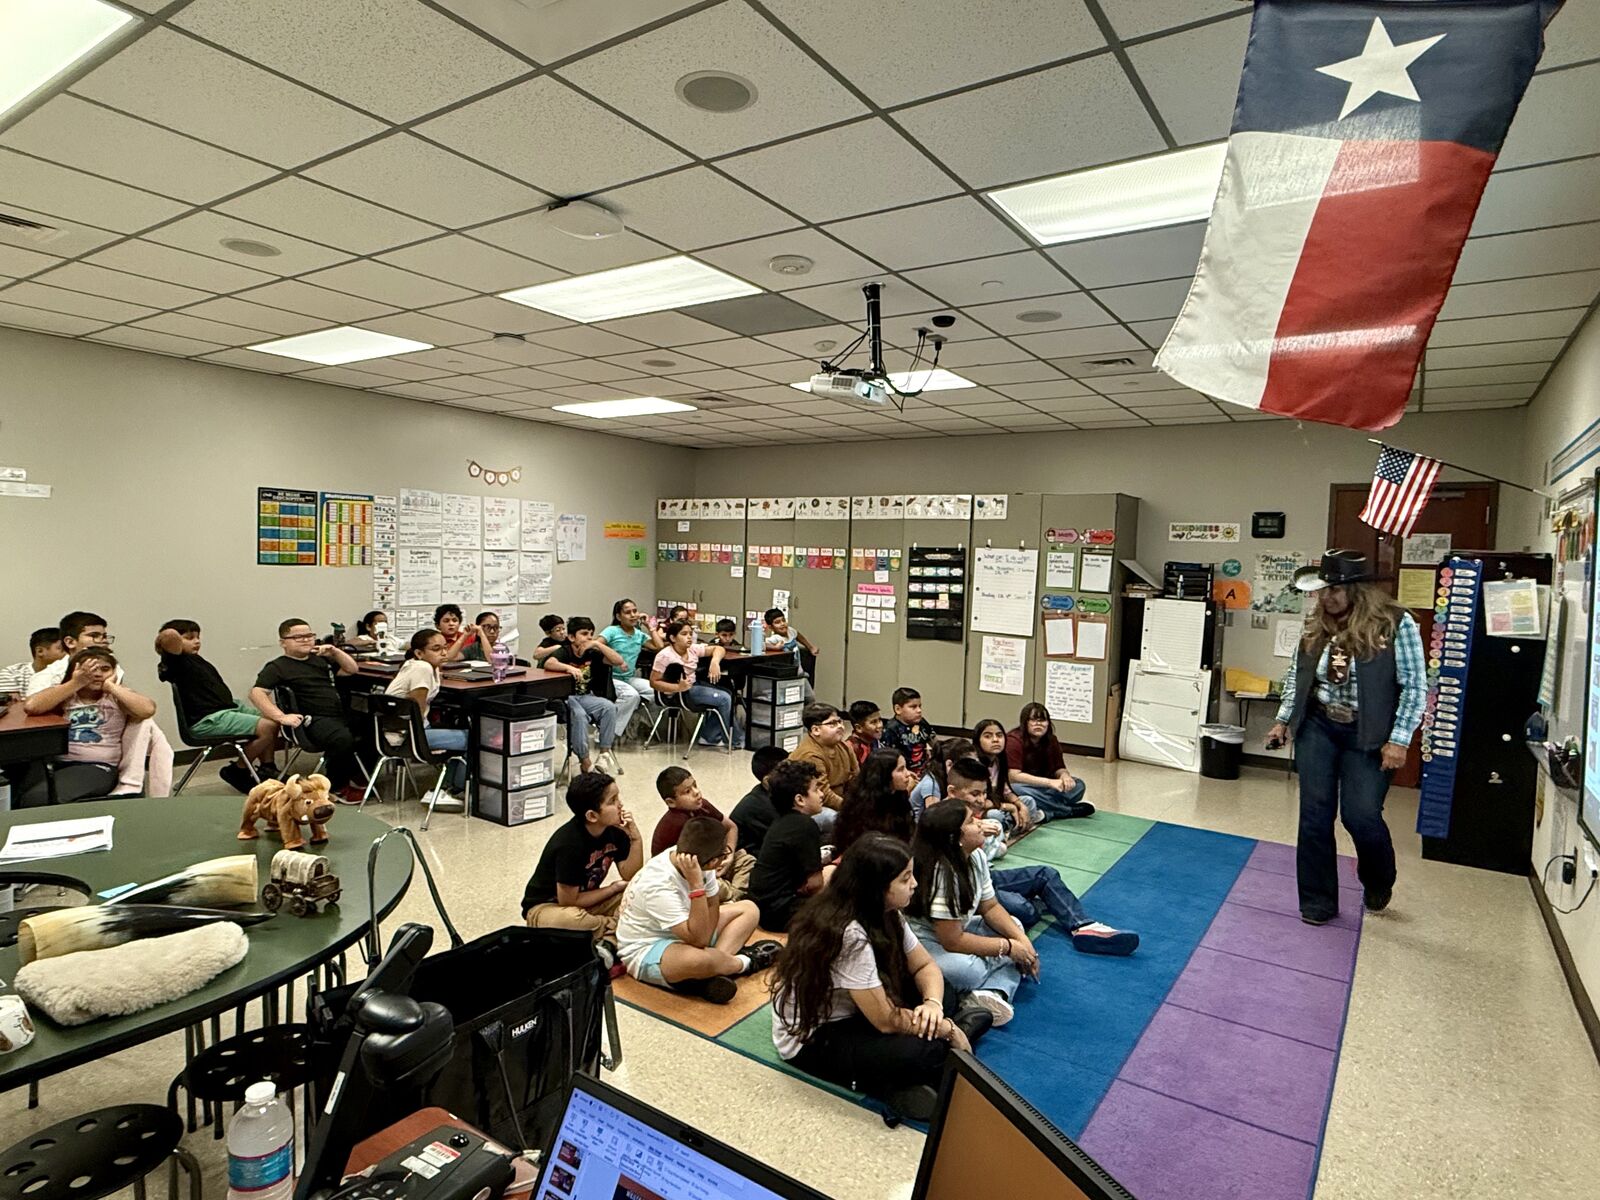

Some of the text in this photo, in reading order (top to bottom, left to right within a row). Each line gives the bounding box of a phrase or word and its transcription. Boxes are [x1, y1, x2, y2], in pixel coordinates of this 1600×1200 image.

[1171, 524, 1220, 532] KINDNESS
[634, 551, 640, 560] B
[1225, 588, 1236, 600] A
[511, 1015, 538, 1038] HULKEN
